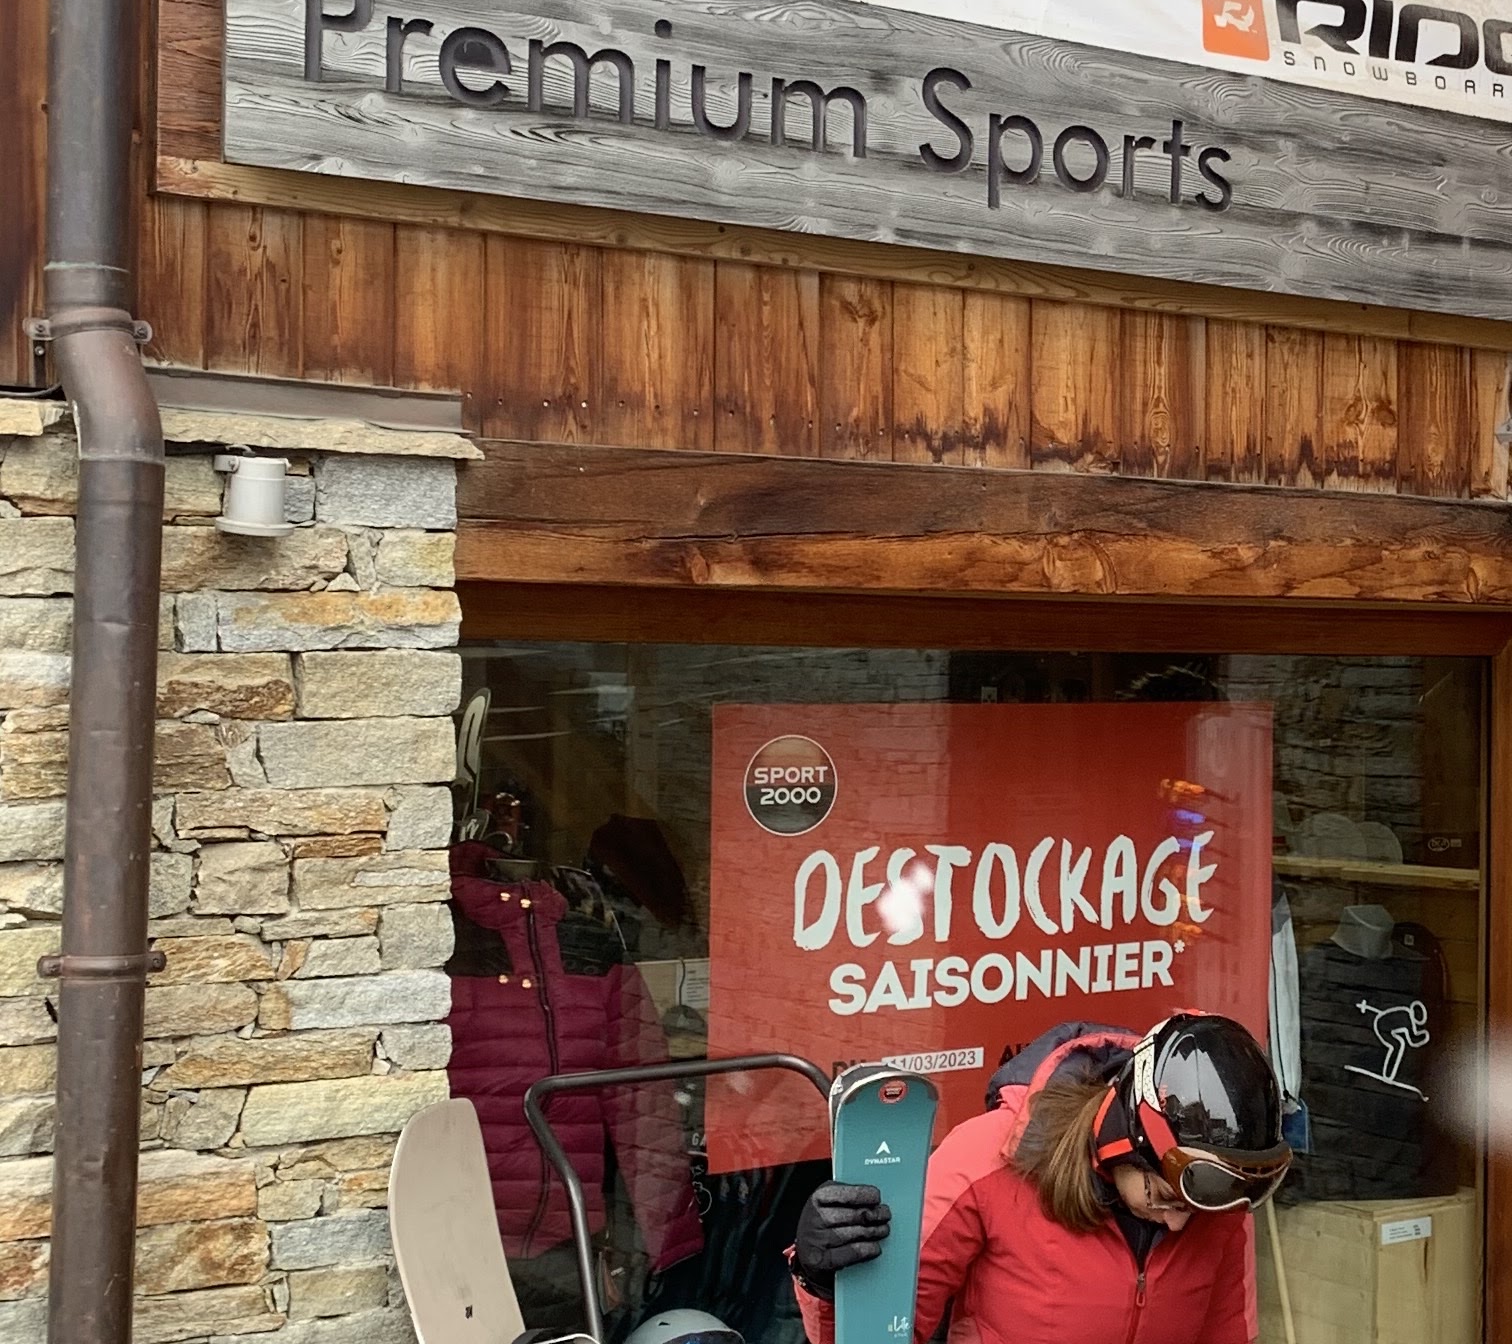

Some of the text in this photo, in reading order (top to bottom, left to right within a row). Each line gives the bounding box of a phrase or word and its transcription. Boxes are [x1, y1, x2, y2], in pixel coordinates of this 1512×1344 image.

[918, 66, 1233, 212] Sports
[753, 765, 829, 786] SPORT
[759, 786, 822, 806] 2000
[793, 830, 1218, 951] DESTOCKAGE
[864, 1157, 901, 1165] DYNASTAR
